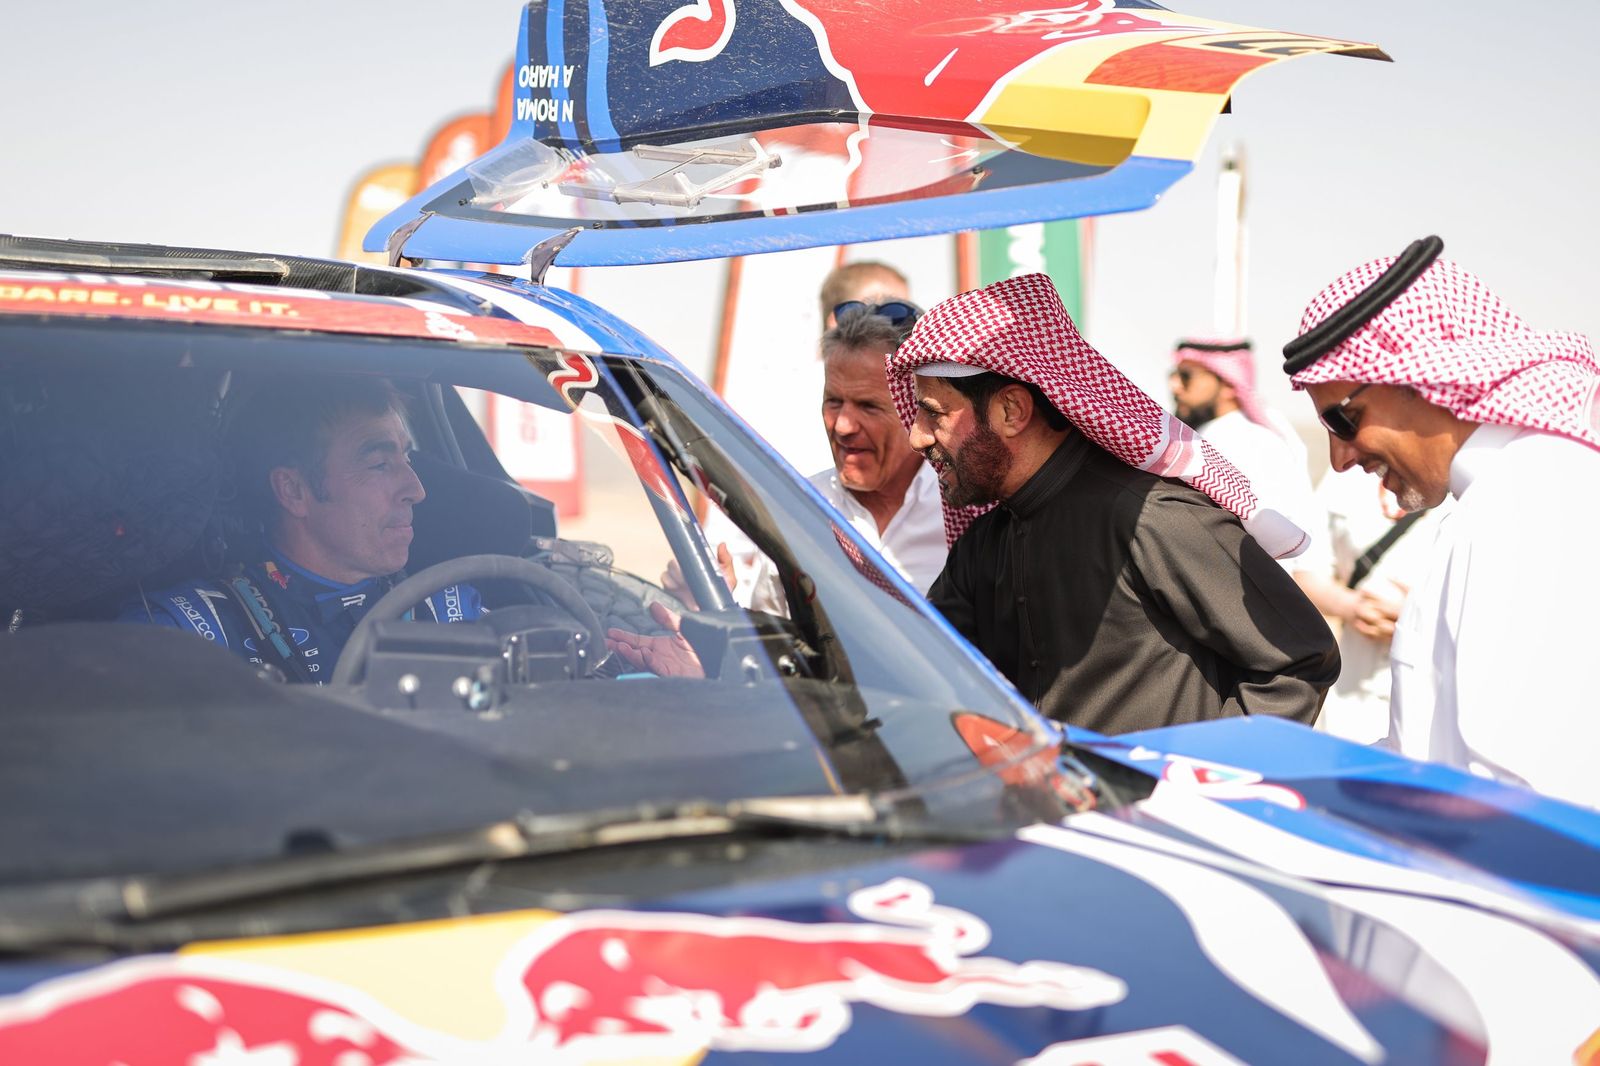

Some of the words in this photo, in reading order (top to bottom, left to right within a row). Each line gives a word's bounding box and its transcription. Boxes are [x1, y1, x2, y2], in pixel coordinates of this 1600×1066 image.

[518, 65, 560, 88] HARO
[563, 65, 574, 88] A
[517, 98, 559, 122] ROMA
[562, 99, 574, 123] N
[143, 293, 239, 312] LIVE
[250, 300, 299, 317] IT.
[444, 586, 463, 623] parc
[171, 596, 215, 641] sparco
